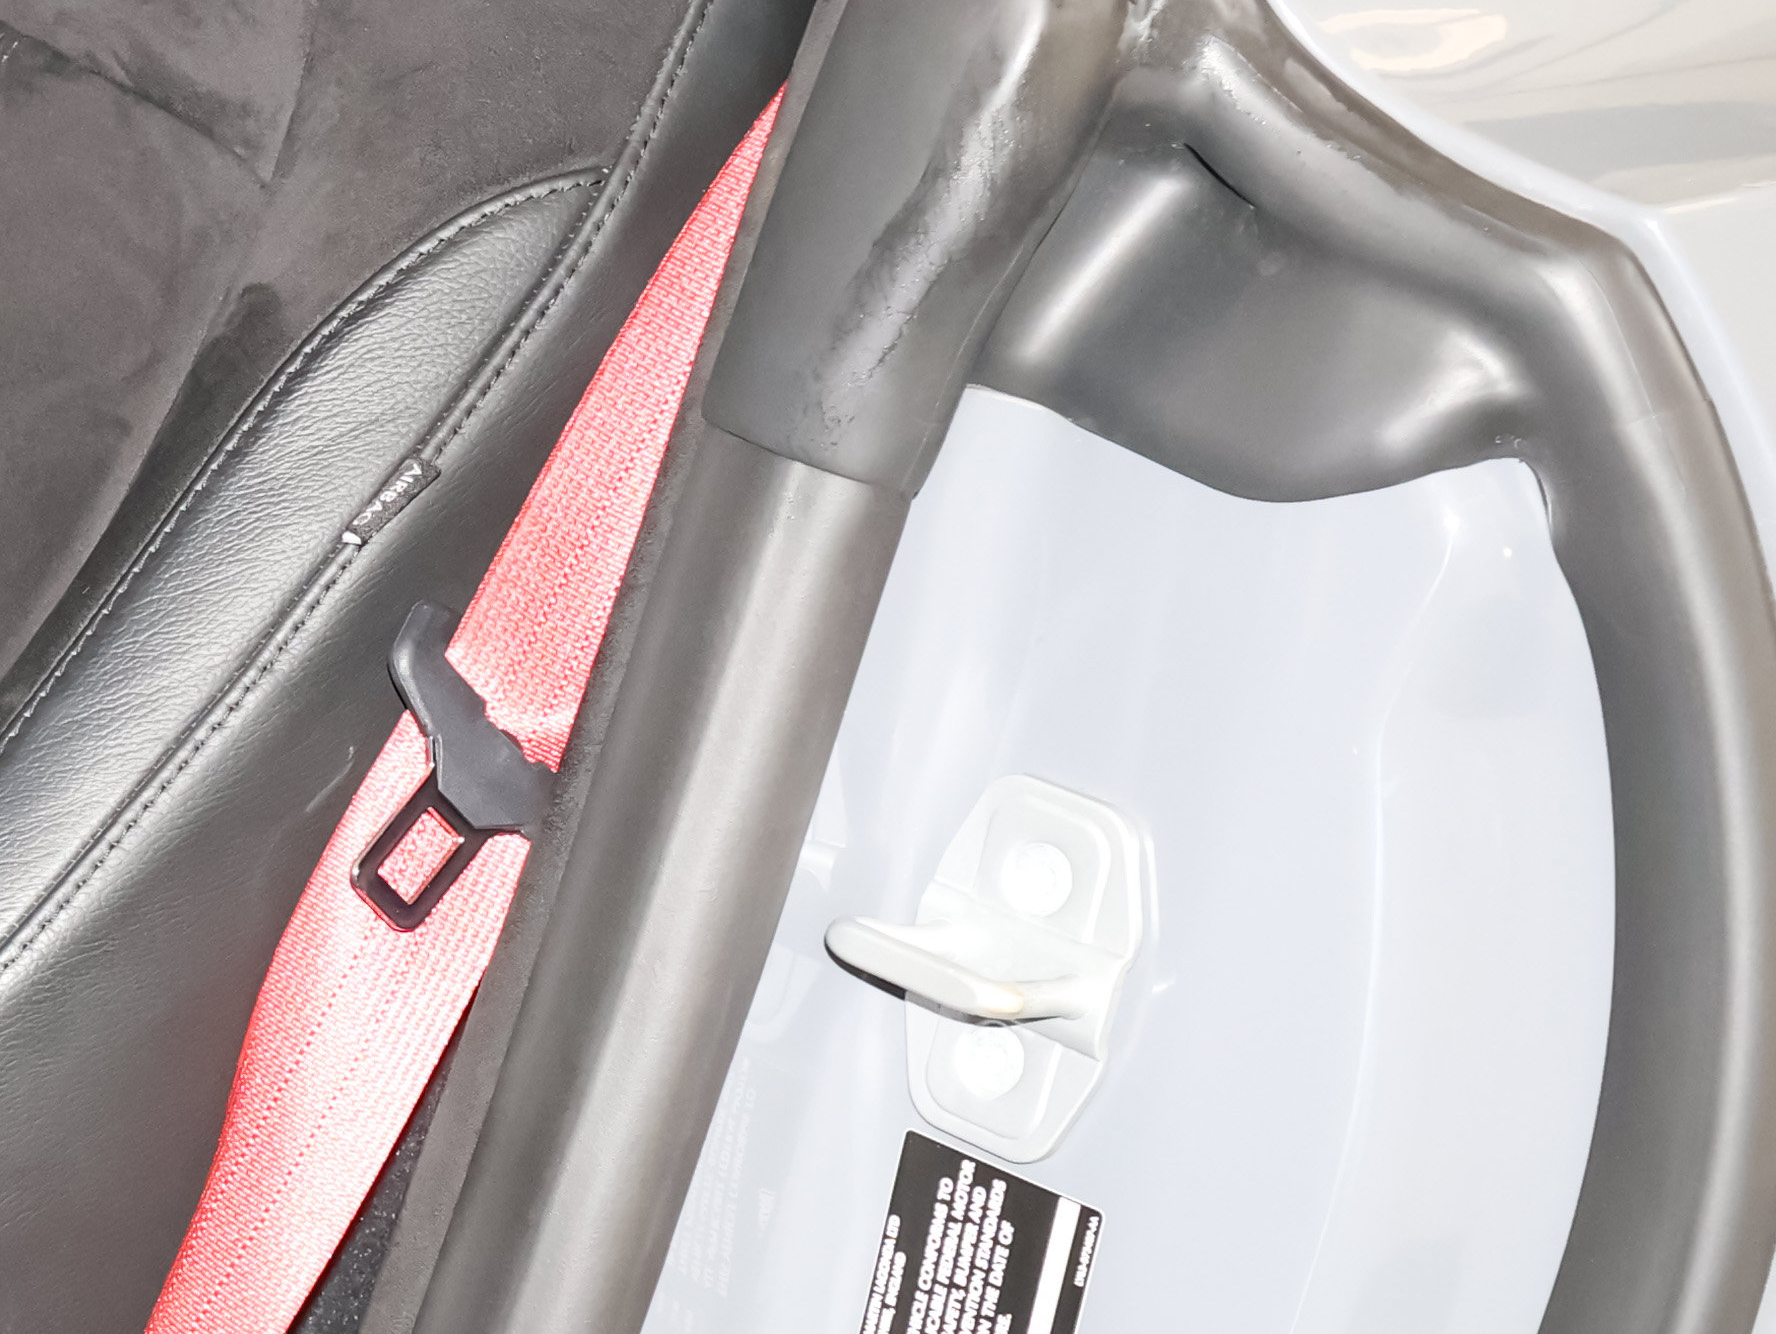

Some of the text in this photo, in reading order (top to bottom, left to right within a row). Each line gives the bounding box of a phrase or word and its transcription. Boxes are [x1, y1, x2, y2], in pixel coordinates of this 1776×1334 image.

[352, 463, 422, 525] AIRBAG
[872, 1238, 896, 1294] LAGONDA
[885, 1214, 900, 1238] LTD
[917, 1201, 948, 1291] CONFORMS
[936, 1177, 953, 1201] TO
[935, 1221, 962, 1284] FEDERAL
[950, 1159, 975, 1220] MOTOR
[952, 1221, 979, 1287] BUMPER
[967, 1185, 986, 1224] AND
[974, 1178, 1006, 1270] STANDARDS
[997, 1219, 1014, 1245] OF
[980, 1285, 1000, 1317] THE
[987, 1244, 1009, 1286] DATE
